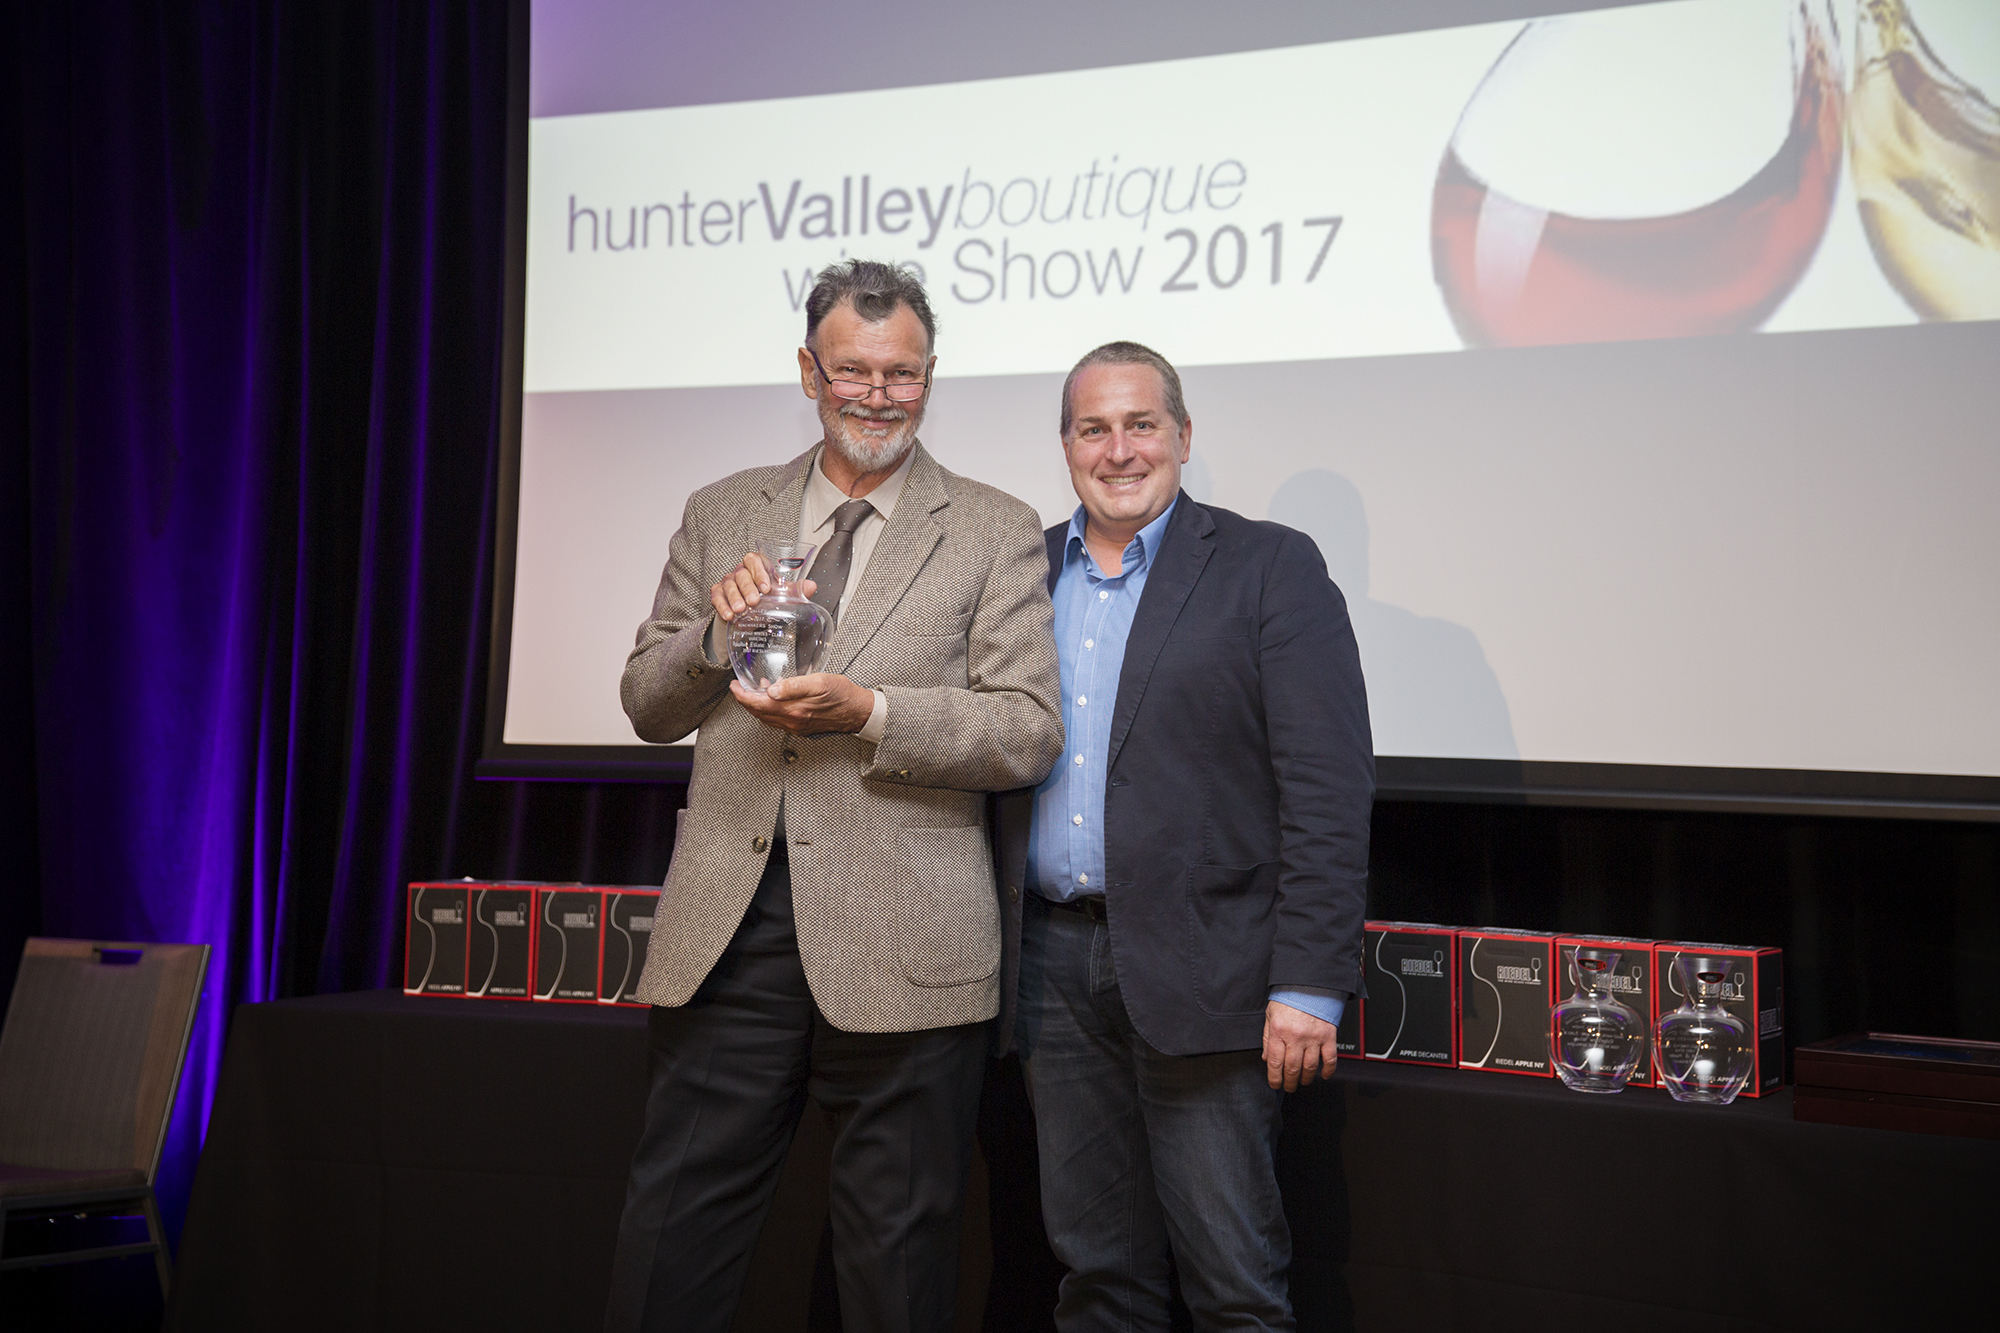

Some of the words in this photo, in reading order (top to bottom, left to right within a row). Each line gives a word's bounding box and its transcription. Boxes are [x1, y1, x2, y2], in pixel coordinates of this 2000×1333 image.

[781, 248, 926, 313] we
[951, 236, 1144, 305] Show
[1160, 216, 1343, 293] 2017
[1401, 959, 1434, 974] RIEDEL
[1497, 965, 1531, 981] RIEDEL
[1399, 1049, 1417, 1057] APPLE
[1418, 1051, 1449, 1060] DECANTER
[1495, 1058, 1514, 1066] RIEDEL
[1514, 1060, 1534, 1068] APPLE
